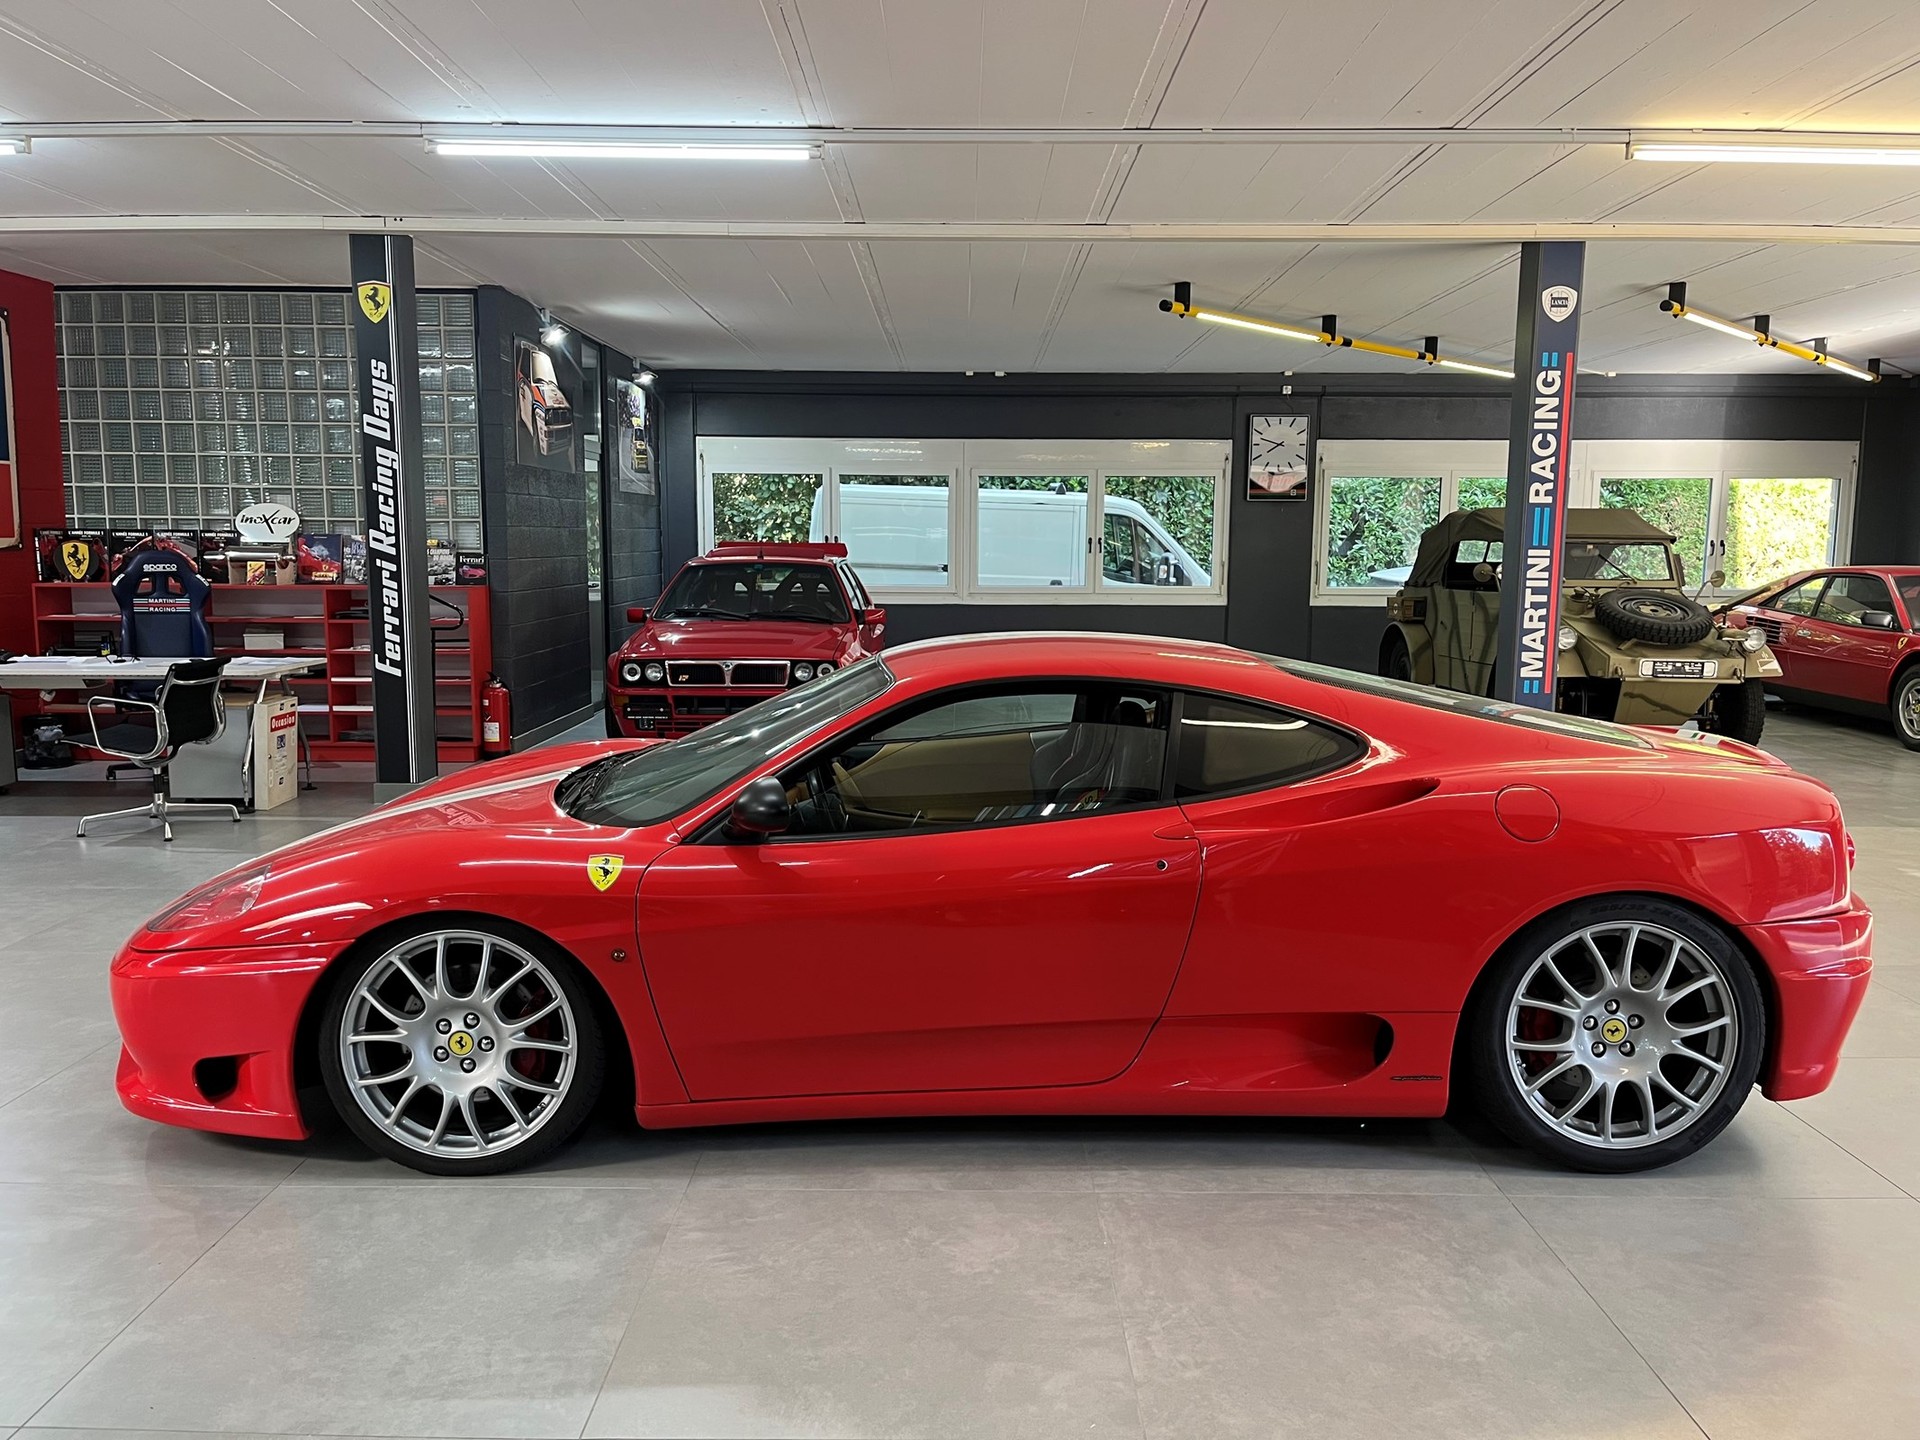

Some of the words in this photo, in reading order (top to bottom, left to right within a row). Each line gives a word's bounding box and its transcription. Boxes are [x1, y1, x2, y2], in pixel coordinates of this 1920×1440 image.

[362, 358, 395, 442] Days
[1528, 369, 1562, 504] RACING
[368, 445, 399, 556] Racing
[142, 563, 177, 572] sparco
[459, 555, 485, 564] Ferrari
[375, 558, 402, 677] Ferrari
[1520, 548, 1551, 678] MARTINI
[271, 715, 295, 729] Occasion
